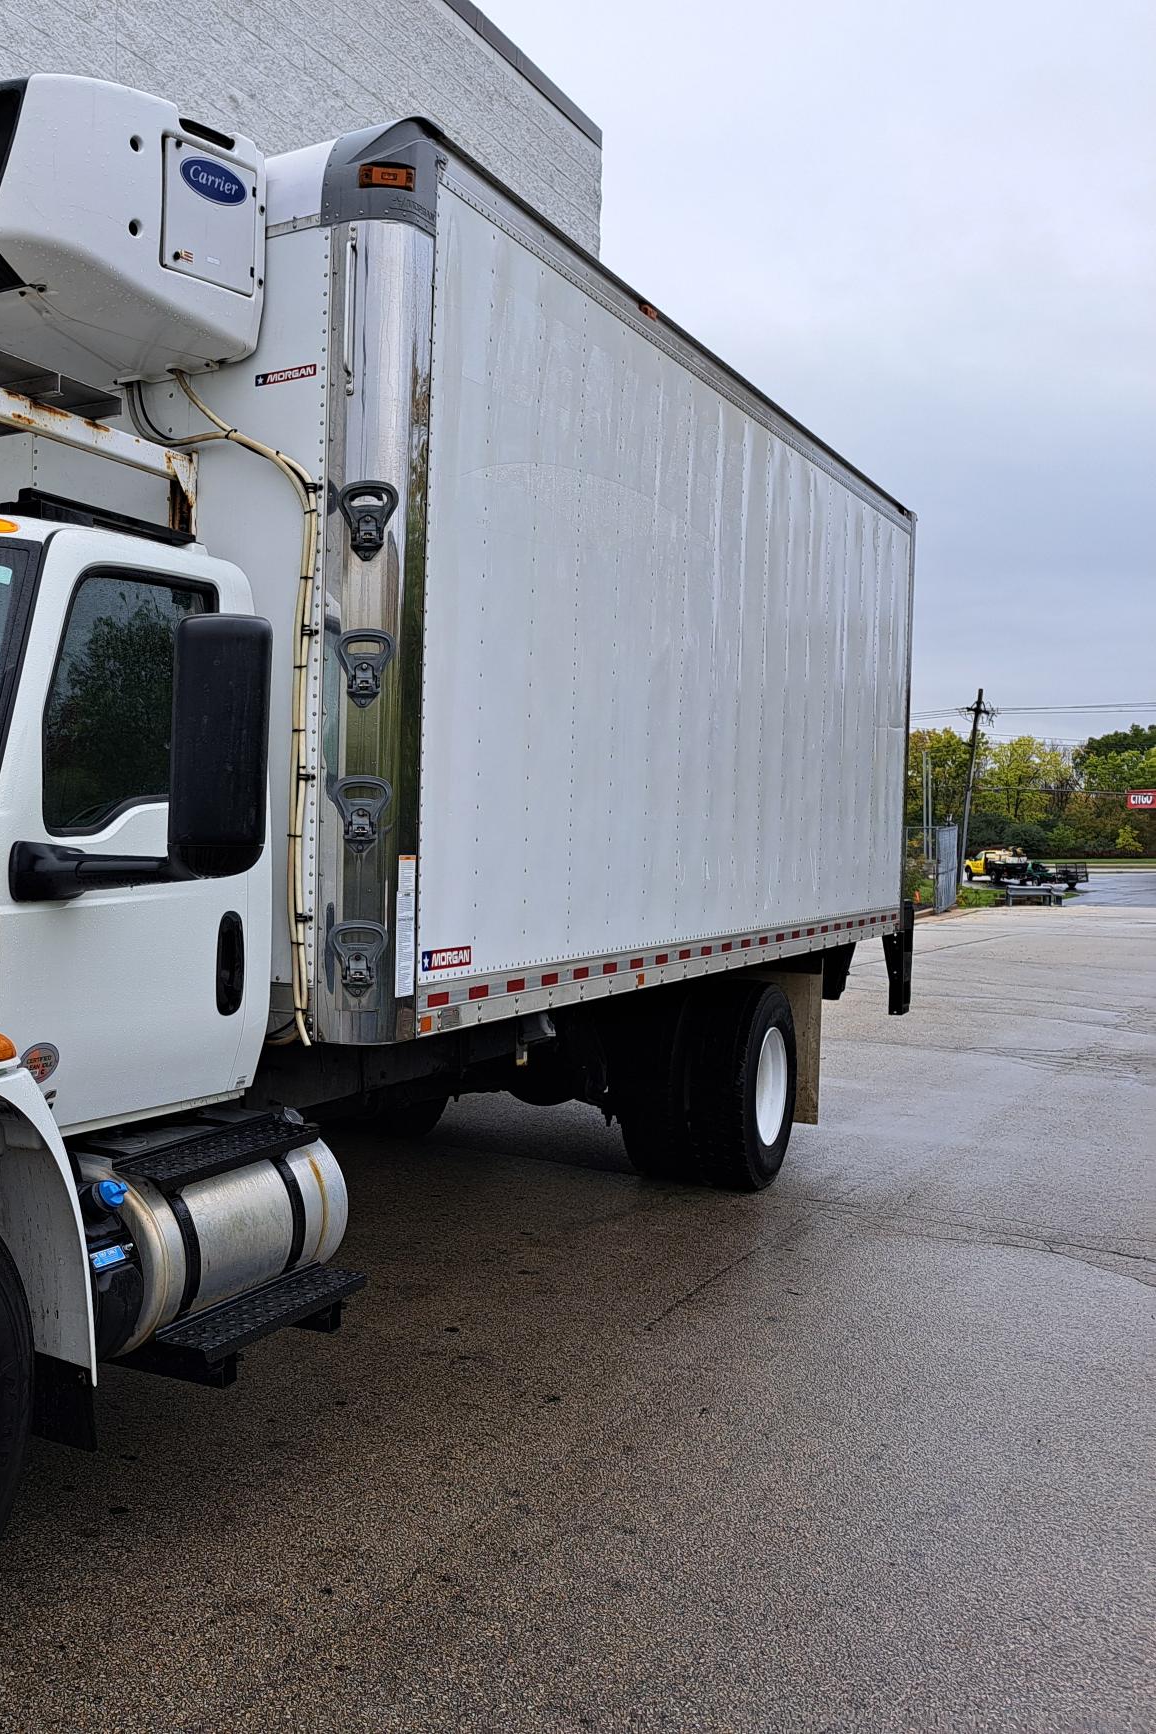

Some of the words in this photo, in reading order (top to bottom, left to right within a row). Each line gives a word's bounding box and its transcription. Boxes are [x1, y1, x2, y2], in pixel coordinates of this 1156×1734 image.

[189, 165, 239, 196] Carrier
[266, 365, 315, 384] MORGAN
[1130, 794, 1153, 805] CITGO
[431, 948, 471, 968] MORGAN
